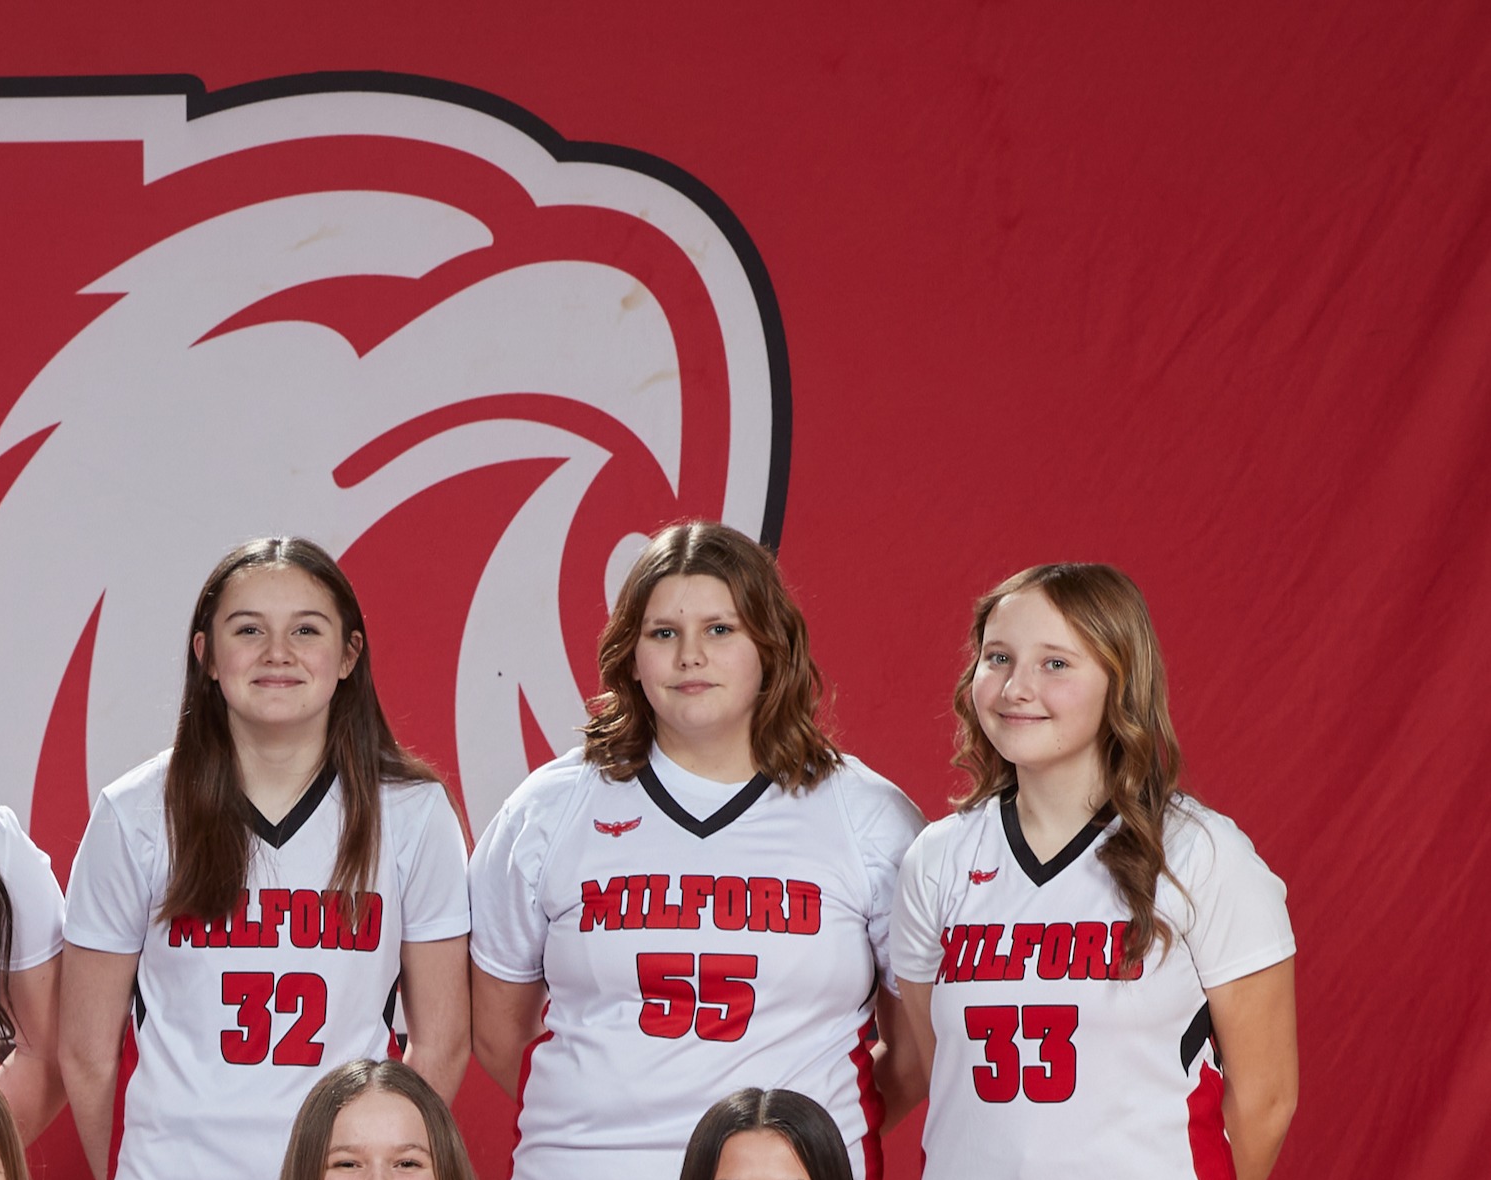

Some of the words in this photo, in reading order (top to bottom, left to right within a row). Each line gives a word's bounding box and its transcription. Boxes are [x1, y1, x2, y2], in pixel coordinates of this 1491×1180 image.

[580, 874, 822, 935] MILFORD
[221, 971, 327, 1066] 32
[636, 952, 758, 1042] 55
[964, 1004, 1078, 1103] 33
